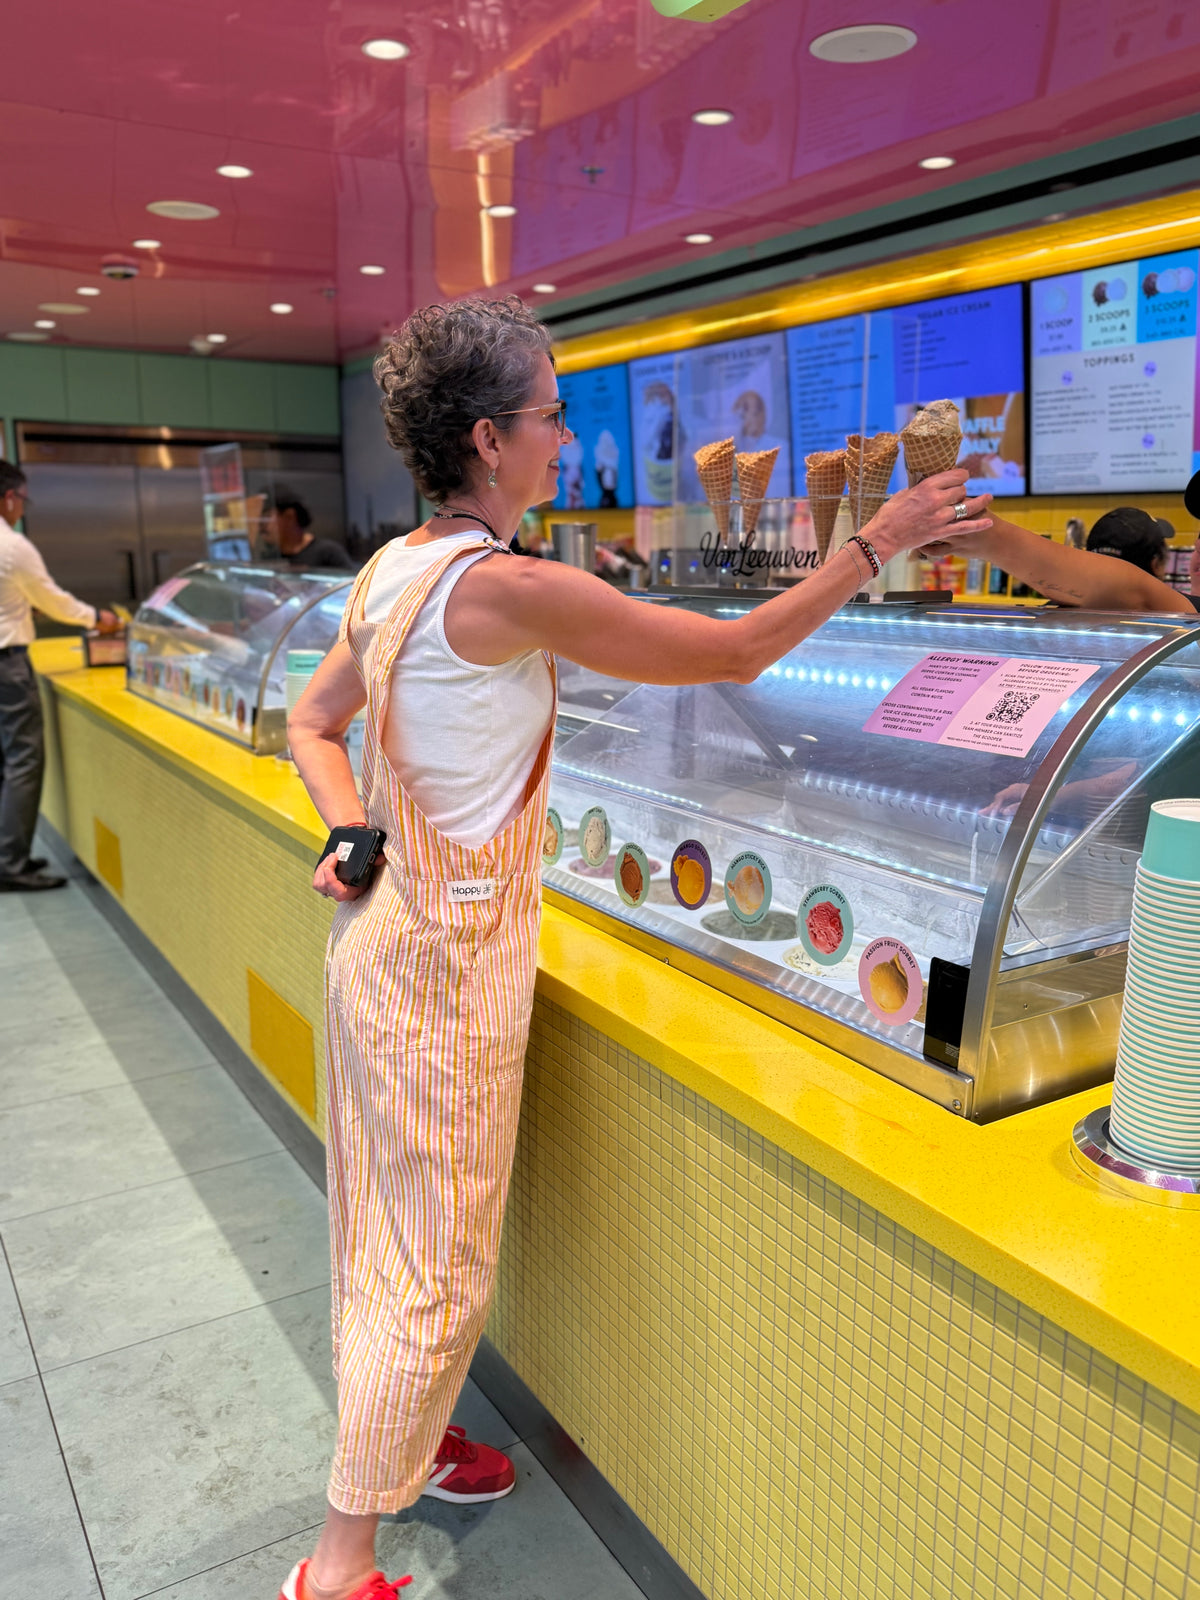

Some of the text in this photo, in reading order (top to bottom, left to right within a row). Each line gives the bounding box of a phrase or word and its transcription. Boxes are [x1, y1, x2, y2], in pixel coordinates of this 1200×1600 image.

[1151, 299, 1190, 313] SCOOPS
[1095, 309, 1130, 322] SCOOPS
[1045, 318, 1073, 330] SCOOP
[1083, 353, 1135, 368] TOPPINGS
[928, 655, 999, 666] ALLERGY WARNING
[896, 704, 933, 713] CONTAMINATION
[730, 853, 766, 871] MANGO STICKY RICE
[451, 885, 481, 896] Happy
[802, 885, 846, 908] STRAWBERRY SORBET
[865, 940, 916, 969] PASSION FRUIT SORBET
